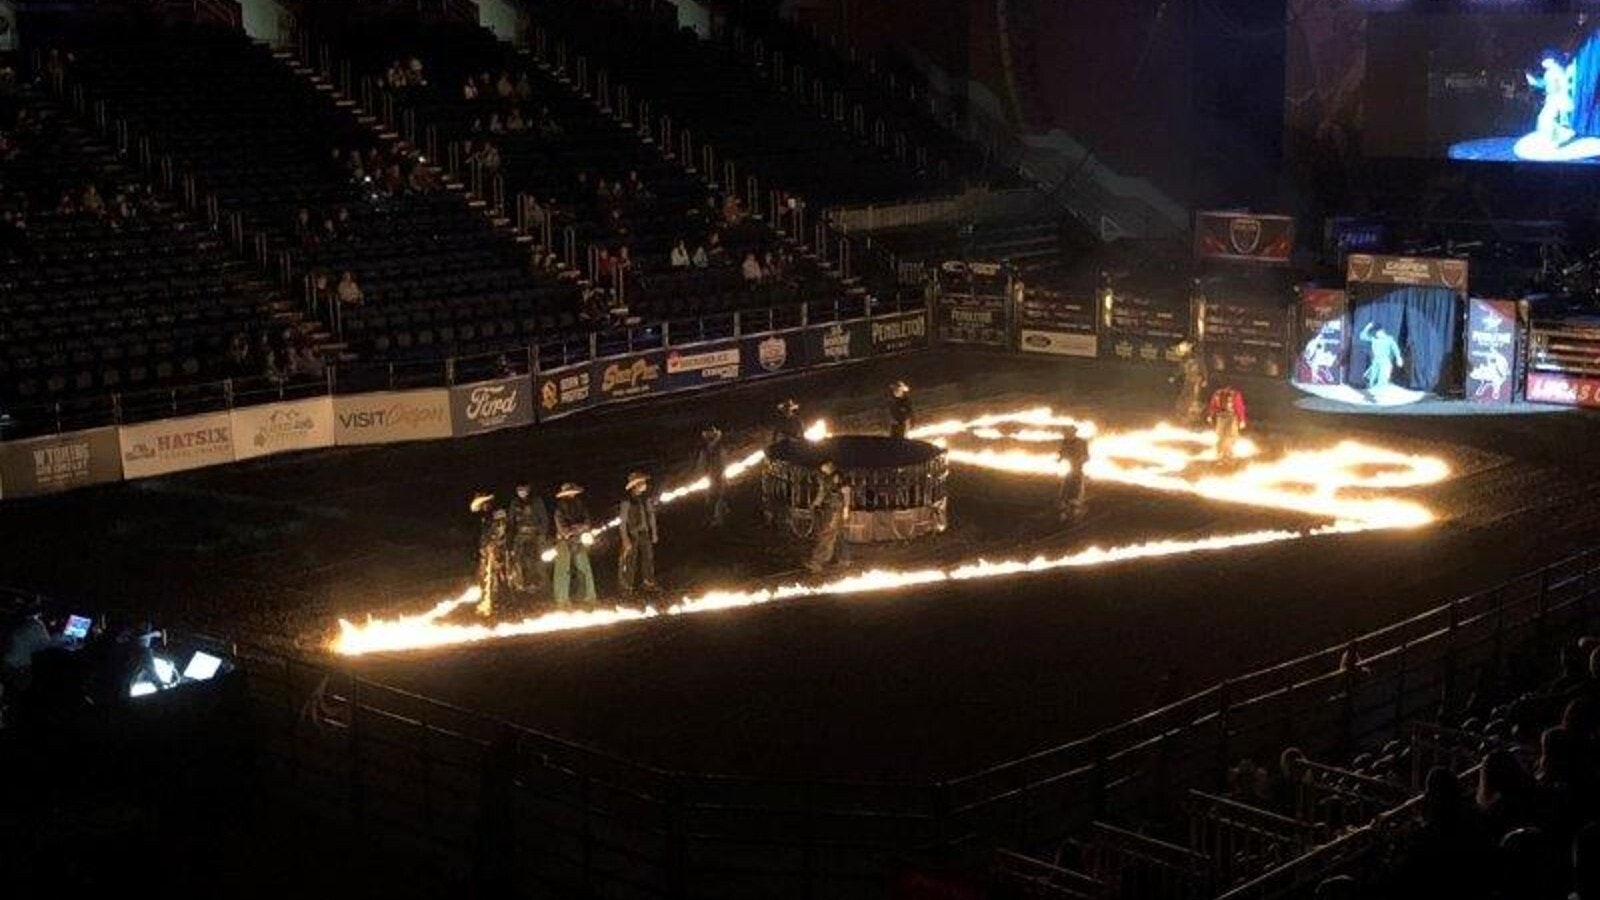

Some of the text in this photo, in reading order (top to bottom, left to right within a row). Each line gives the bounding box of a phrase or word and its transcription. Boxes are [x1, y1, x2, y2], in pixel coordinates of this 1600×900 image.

[872, 312, 925, 344] PENDLETON
[466, 385, 517, 419] Ford
[339, 409, 384, 429] VISIT
[157, 427, 228, 450] HATSIX
